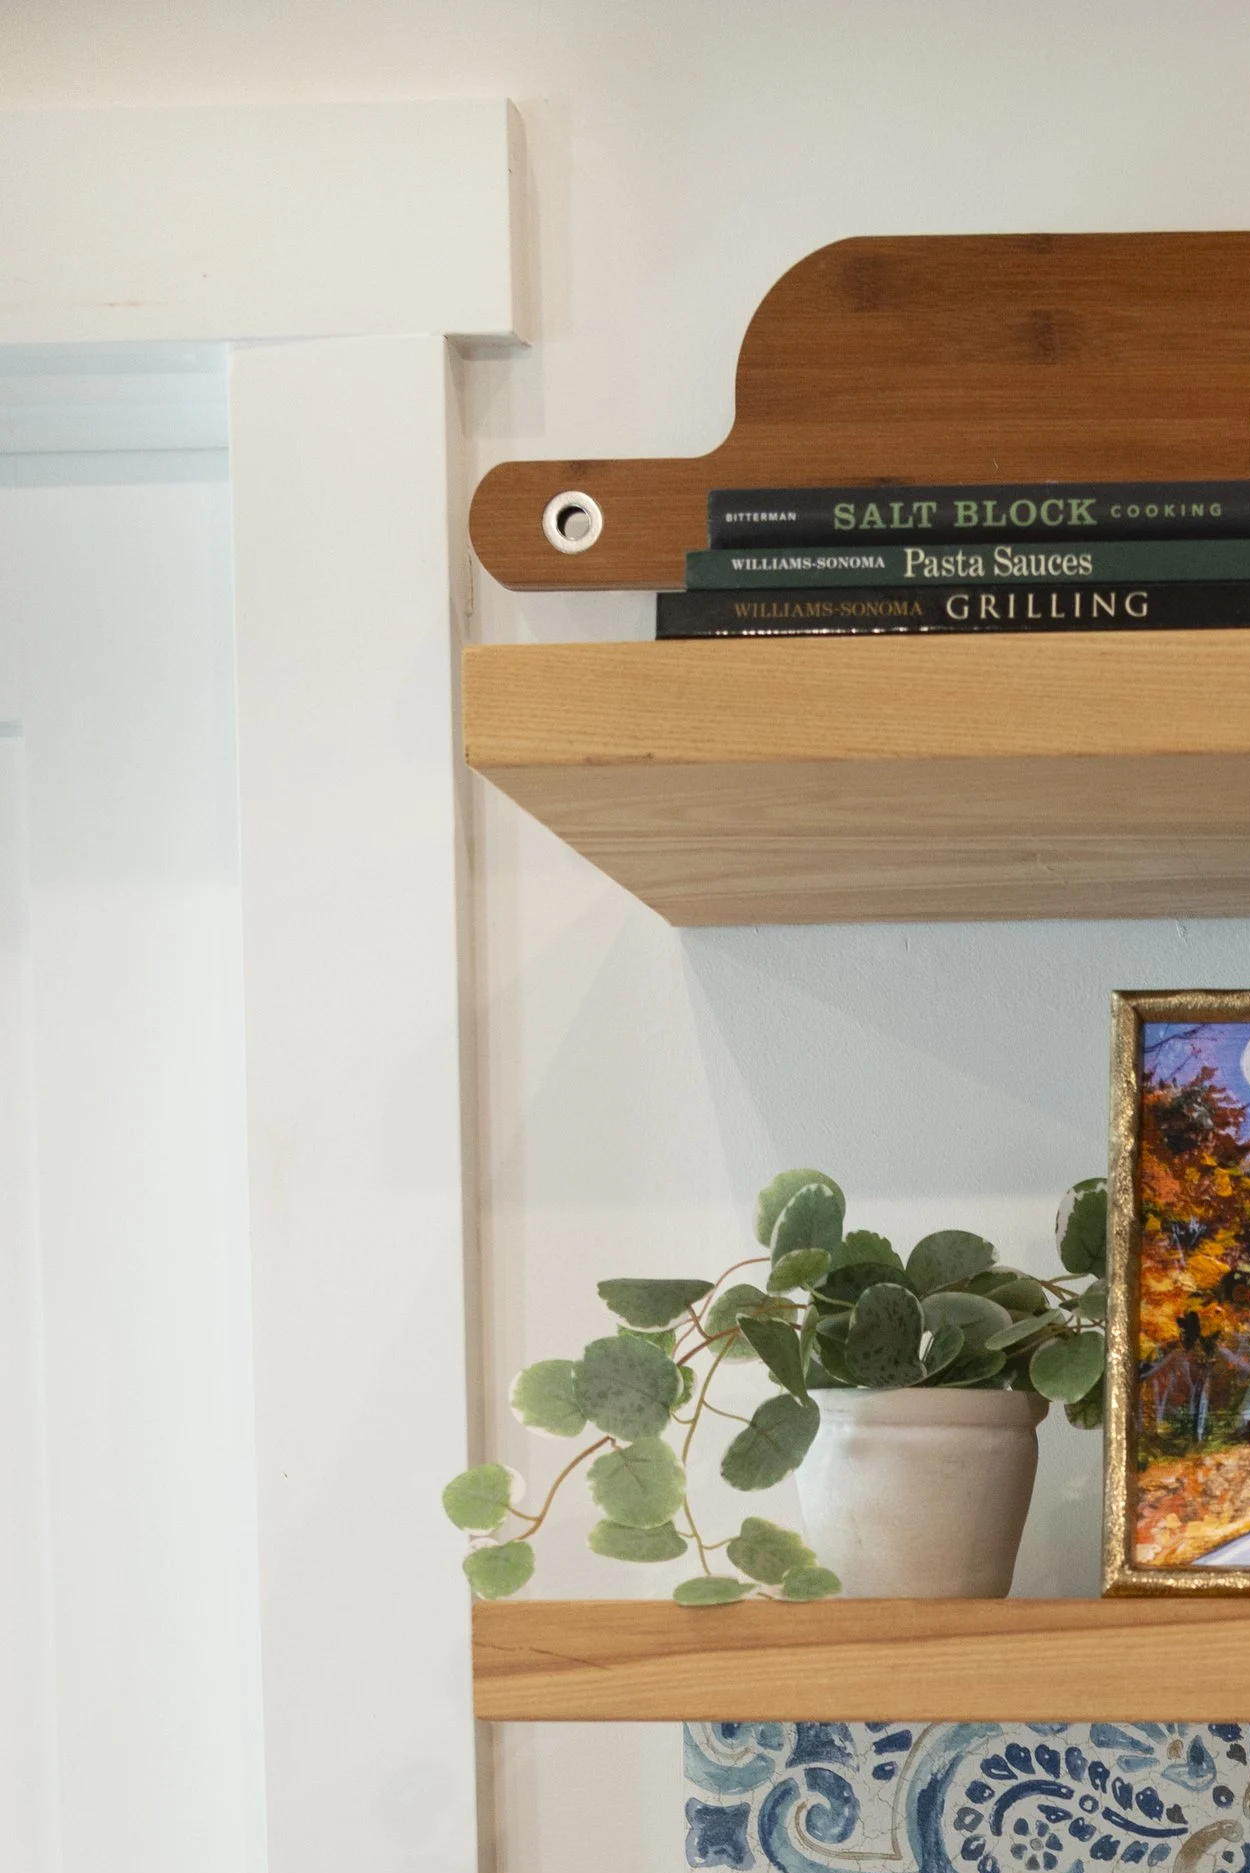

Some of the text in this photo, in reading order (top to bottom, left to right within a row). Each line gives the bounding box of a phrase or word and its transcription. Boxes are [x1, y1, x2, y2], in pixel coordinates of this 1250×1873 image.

[725, 499, 1223, 530] BITTERMAN SALT BLOCK COOKING
[731, 546, 1093, 578] WILLIAMS-SONOMA Pasta Sauces
[735, 591, 1149, 620] WILLIAMS-SONOMA GRILLING
